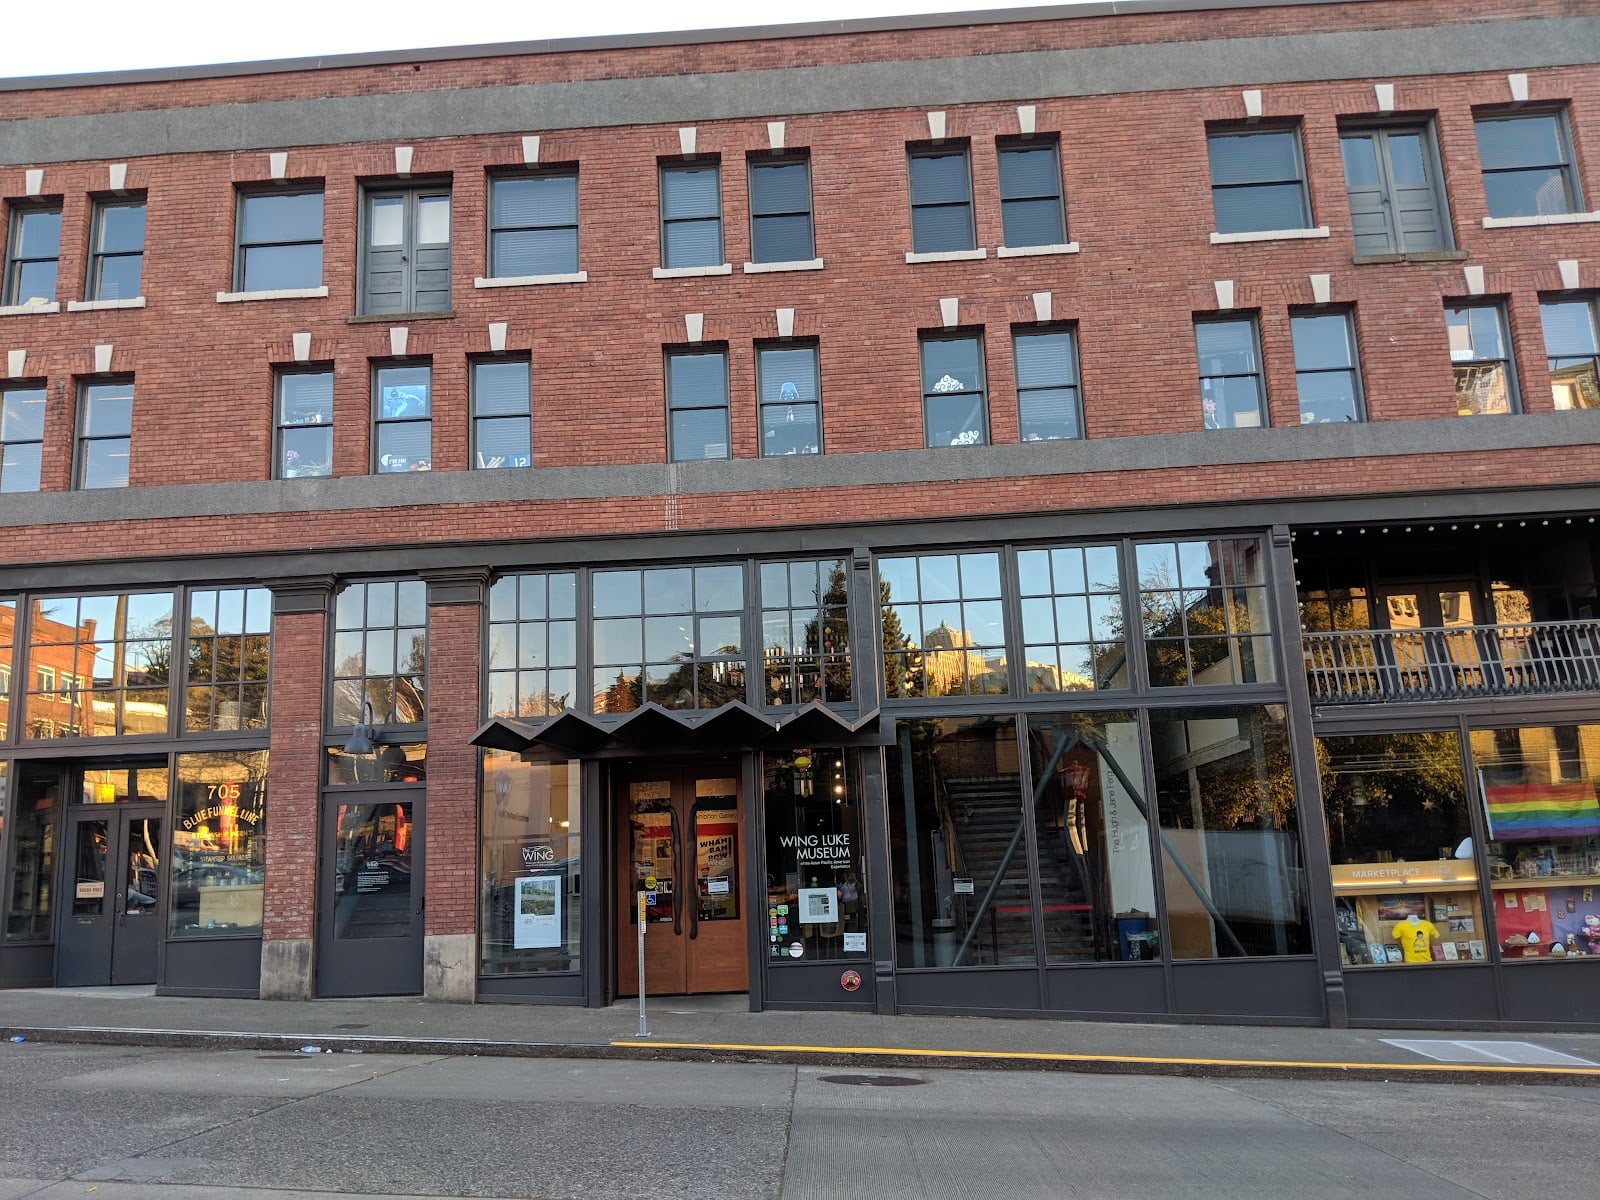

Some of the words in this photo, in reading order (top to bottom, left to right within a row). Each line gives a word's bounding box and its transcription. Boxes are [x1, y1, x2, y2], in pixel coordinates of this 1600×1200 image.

[514, 457, 526, 467] 12
[207, 784, 240, 800] 705
[1108, 790, 1116, 809] Jane
[183, 809, 208, 830] BLUE
[207, 805, 239, 818] FUNNEL
[240, 809, 259, 826] LINE
[1111, 817, 1120, 838] Hugh
[780, 835, 818, 847] WING
[822, 833, 850, 846] LUKE
[1112, 839, 1120, 854] The
[522, 851, 554, 861] WING
[797, 847, 850, 859] MUSEUM
[1352, 868, 1421, 878] MARKETPLACE
